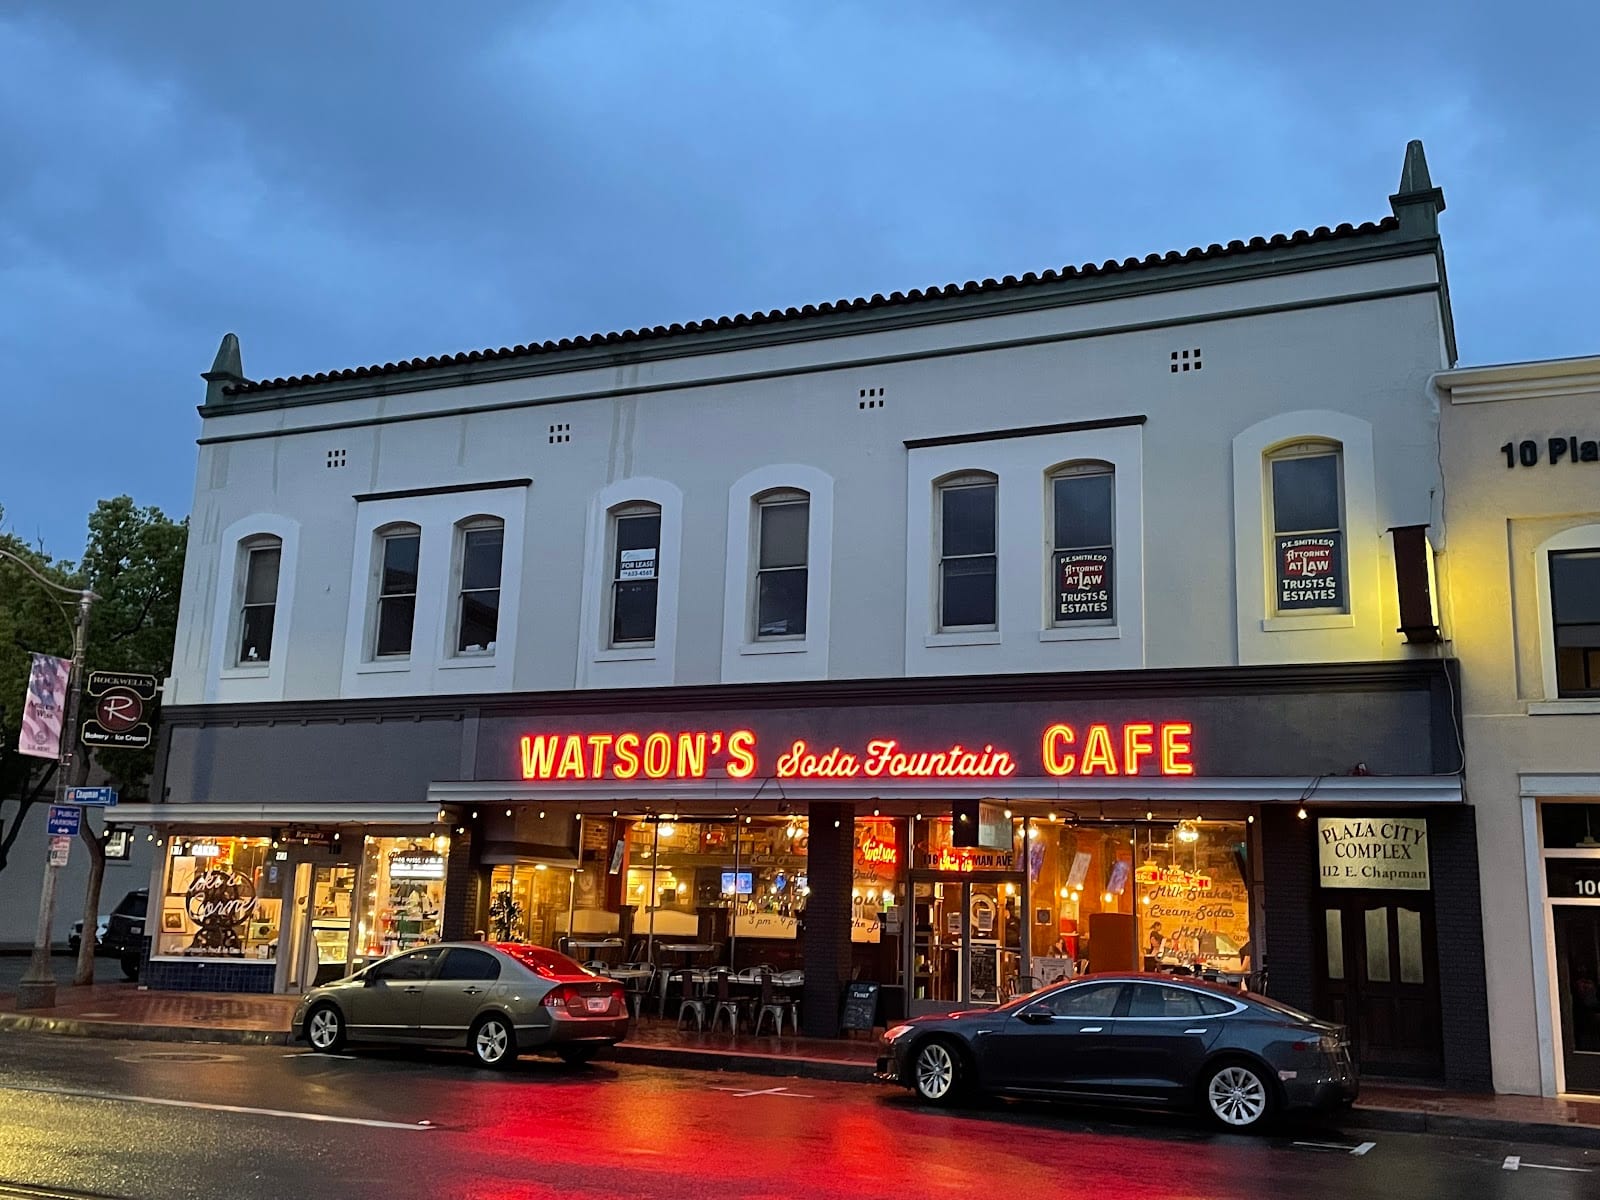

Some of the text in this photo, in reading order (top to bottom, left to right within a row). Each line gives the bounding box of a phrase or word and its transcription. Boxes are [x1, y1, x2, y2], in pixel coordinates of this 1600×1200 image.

[1501, 436, 1600, 468] 10 Pla
[1288, 557, 1329, 577] AT LAW
[1066, 571, 1102, 590] AT LAW
[1282, 578, 1324, 589] TRUSTS
[1061, 592, 1098, 602] TRUSTS
[1282, 589, 1336, 602] ESTATES
[1061, 602, 1108, 613] ESTATES
[521, 729, 757, 779] WATSON'S
[1043, 723, 1194, 776] CAFE
[777, 739, 1016, 777] Soda Fountain
[1321, 822, 1425, 845] PLAZA CITY
[1335, 842, 1412, 859] COMPLEX
[996, 855, 1013, 866] AVE
[1323, 865, 1426, 880] 112 E. Chapman
[1150, 885, 1182, 900] Milk
[1575, 879, 1600, 895] 10
[1150, 904, 1235, 920] Cream Sodas
